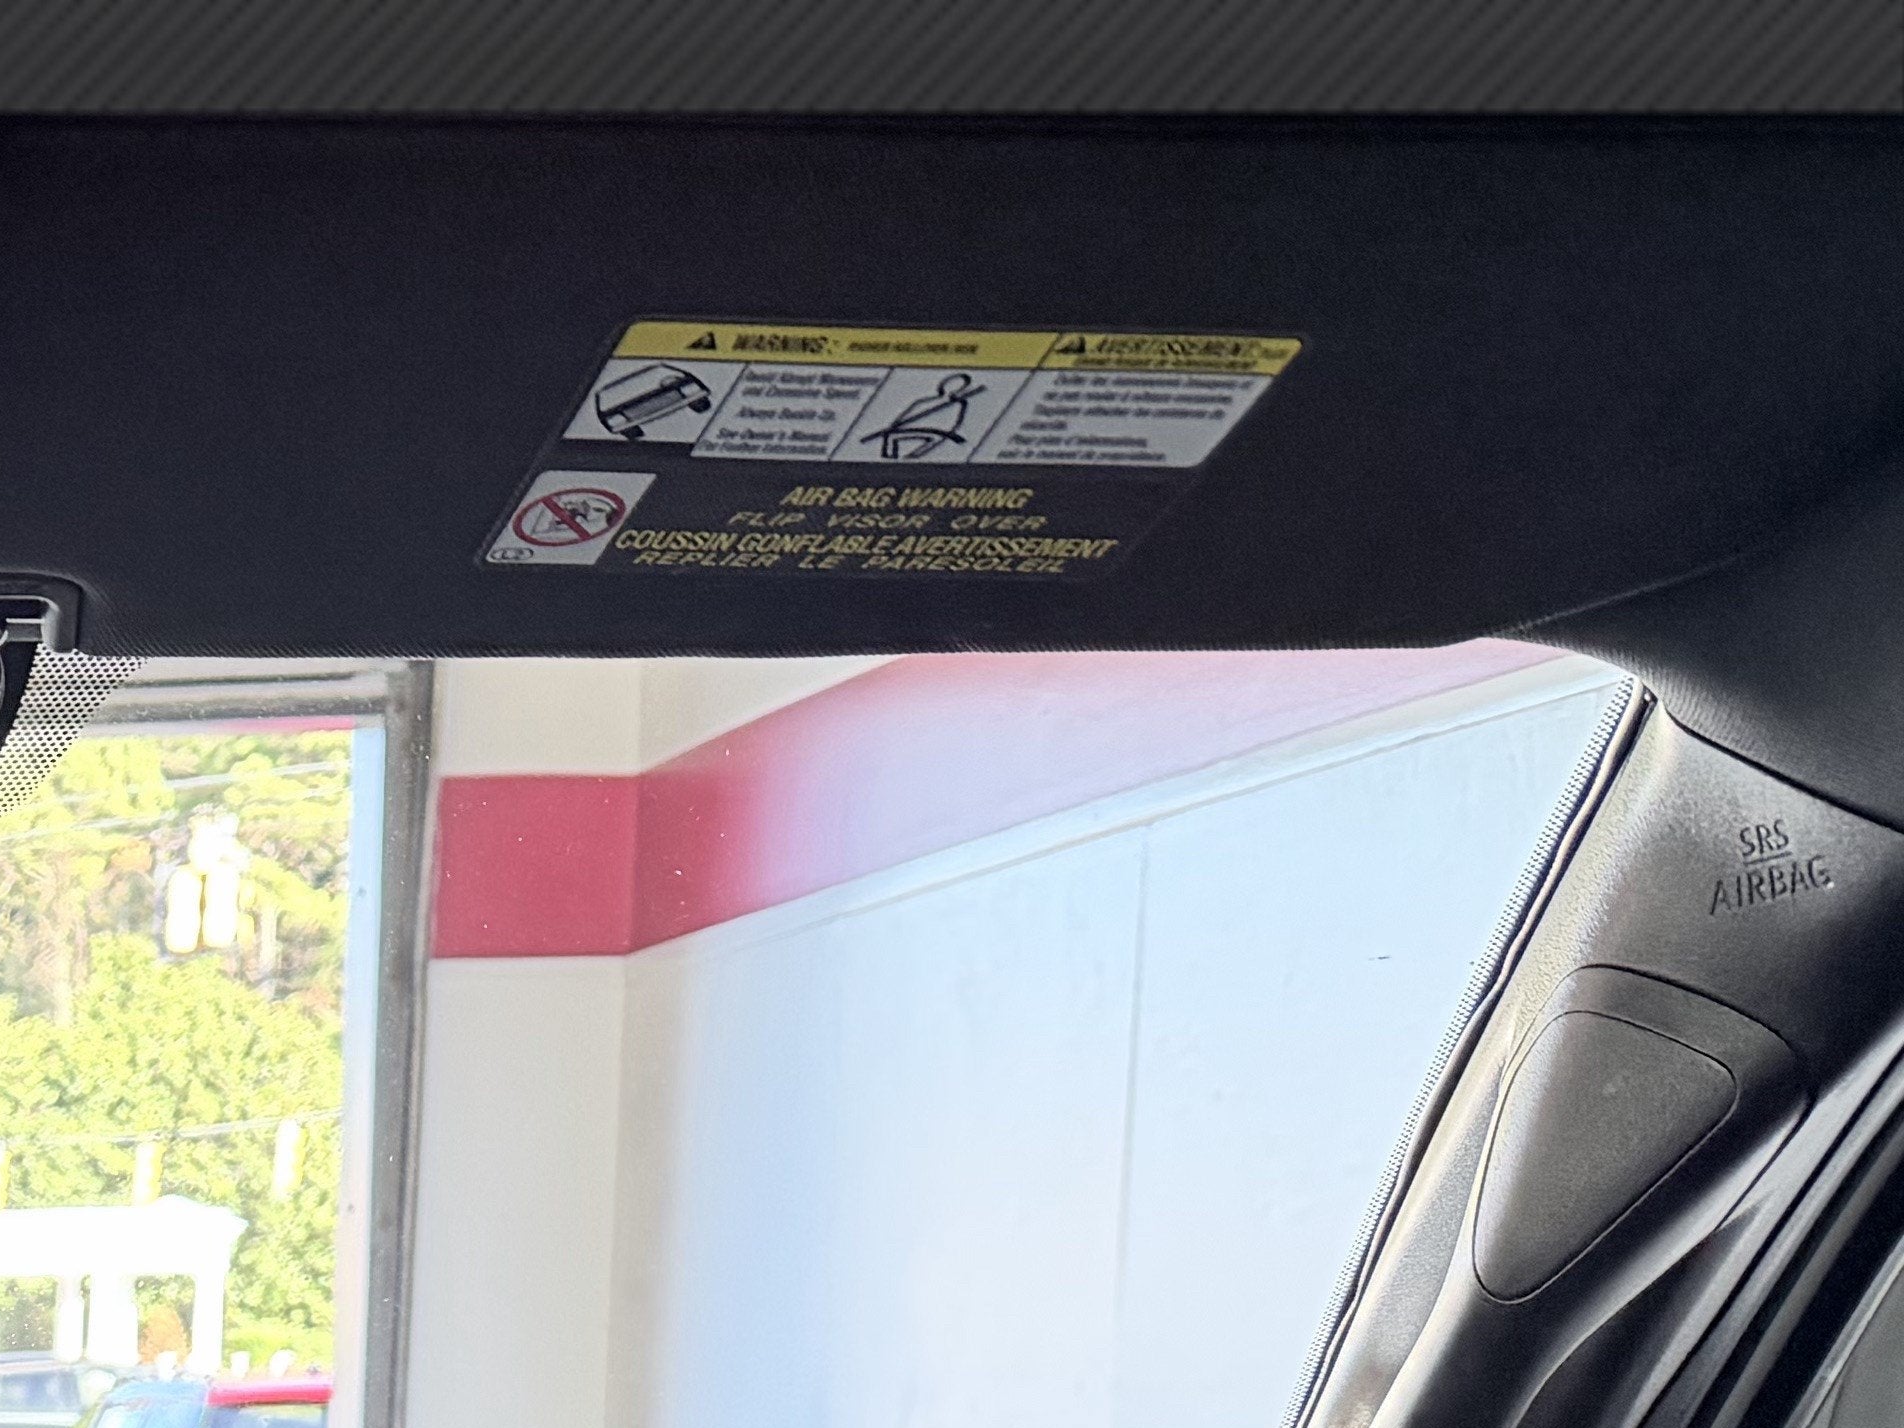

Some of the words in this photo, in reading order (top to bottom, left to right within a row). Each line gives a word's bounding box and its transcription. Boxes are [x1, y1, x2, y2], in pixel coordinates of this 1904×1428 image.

[781, 486, 829, 507] AIR
[835, 486, 897, 507] BAG
[898, 487, 1034, 508] WARNING
[729, 511, 807, 527] FLIP
[827, 513, 932, 529] VISOR
[950, 514, 1049, 530] OVER
[614, 529, 732, 551] COUSSIN
[737, 533, 897, 556] GONFLABLE
[892, 536, 1118, 559] AVERTISSEMENT
[632, 550, 782, 568] REPLIER
[798, 554, 841, 569] LE
[862, 556, 1066, 574] PARESOLEIL
[1738, 818, 1791, 858] SRS
[1709, 854, 1833, 915] AIRBAG
